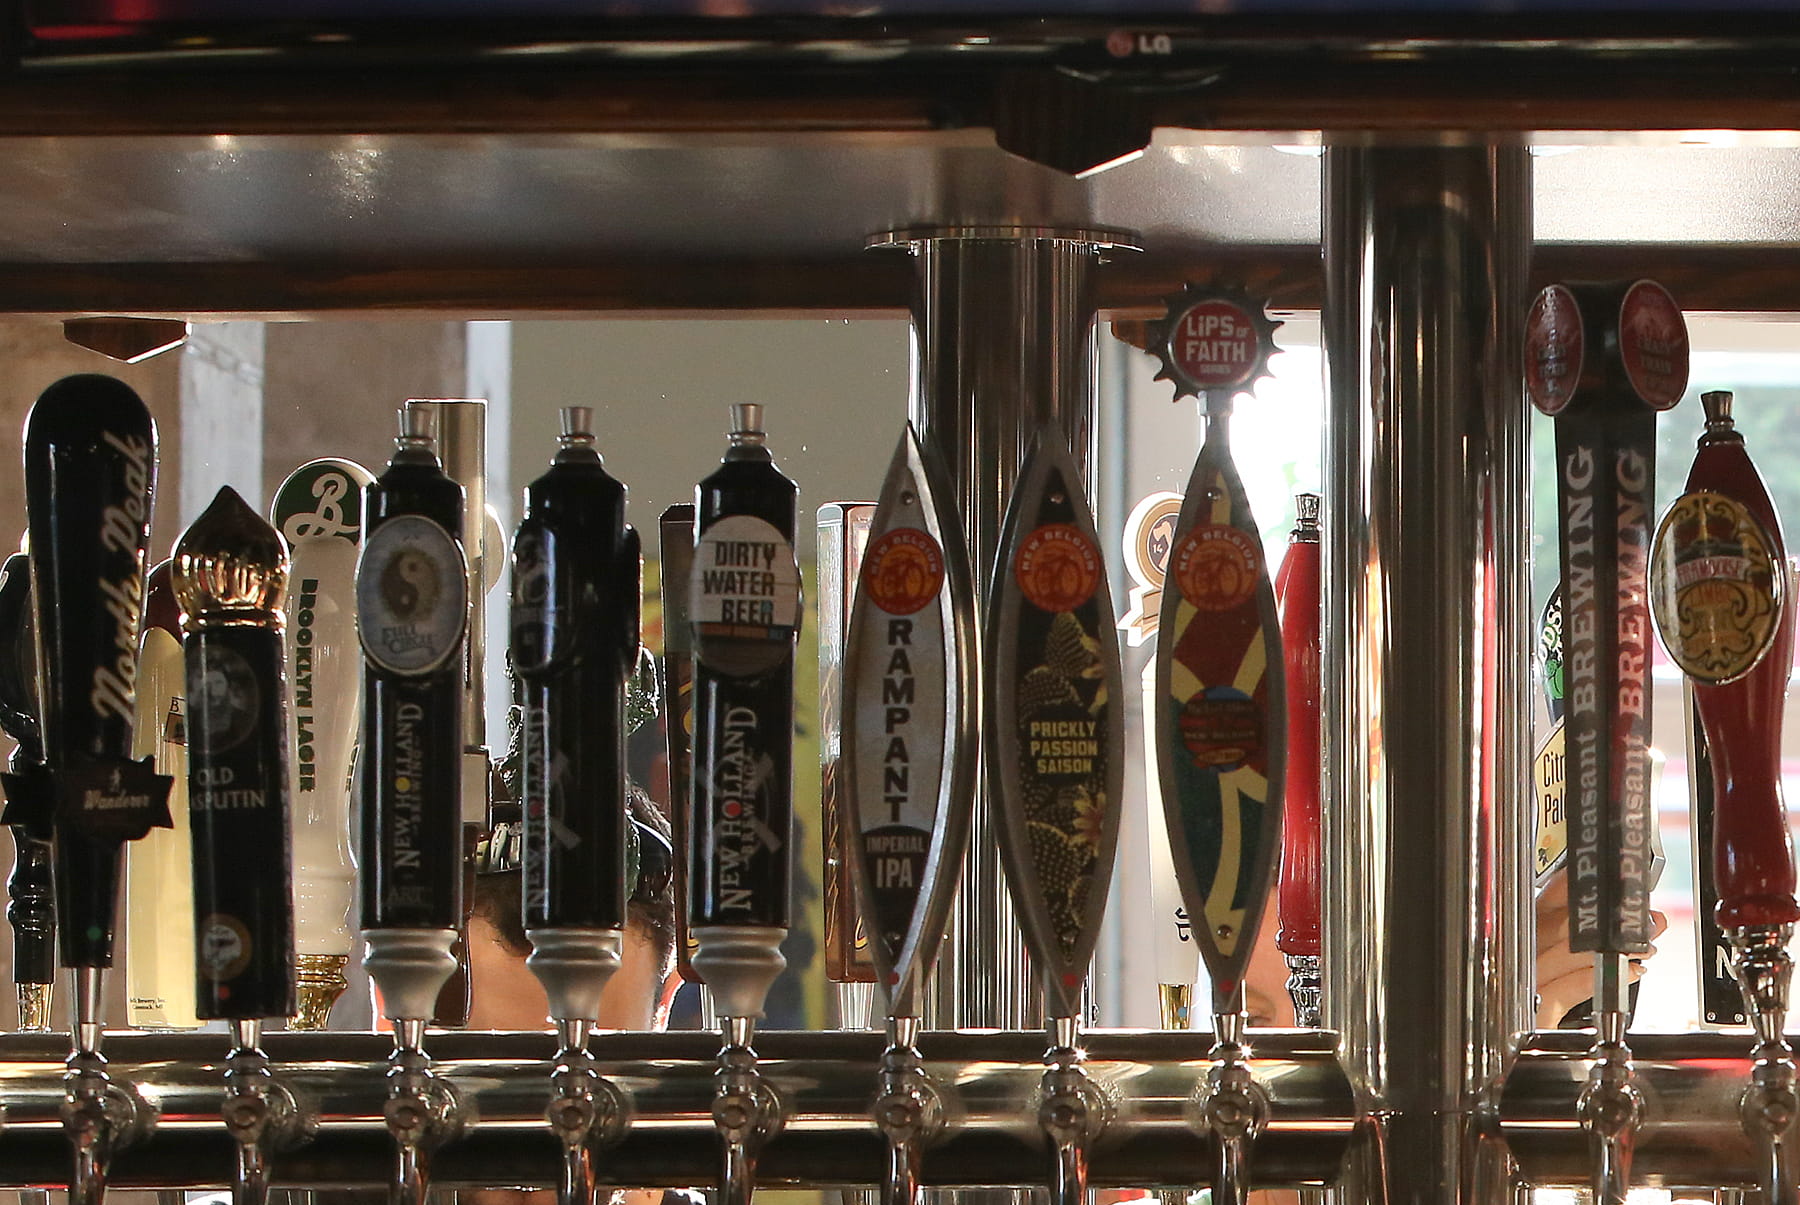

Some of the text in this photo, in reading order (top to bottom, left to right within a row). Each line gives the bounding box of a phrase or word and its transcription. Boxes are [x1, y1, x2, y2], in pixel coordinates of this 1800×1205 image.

[1186, 340, 1246, 362] FAITH
[100, 428, 150, 560] Peak
[714, 540, 775, 568] DIRTY
[870, 535, 939, 576] NEW BELGIUM
[1021, 531, 1096, 572] NEW BELGIUM
[1179, 530, 1256, 572] NEW BELGIUM
[703, 570, 775, 598] WATER
[720, 599, 775, 626] BEER
[296, 578, 319, 709] BROOKLYN
[1566, 445, 1598, 935] Mt. Pleasant BREWING
[1615, 446, 1648, 937] Mt. Pleasant BREWING
[882, 618, 915, 824] RAMPANT
[1030, 720, 1096, 738] PRICKLY
[297, 715, 317, 793] LAGER
[395, 703, 423, 809] HOLLAND
[1030, 740, 1098, 757] PASSION
[1036, 758, 1093, 775] SAISON
[195, 765, 234, 787] OLD
[720, 705, 758, 912] NEW HOLLAND
[395, 821, 420, 868] NEW
[865, 835, 925, 854] IMPERIAL
[875, 856, 914, 889] IPA
